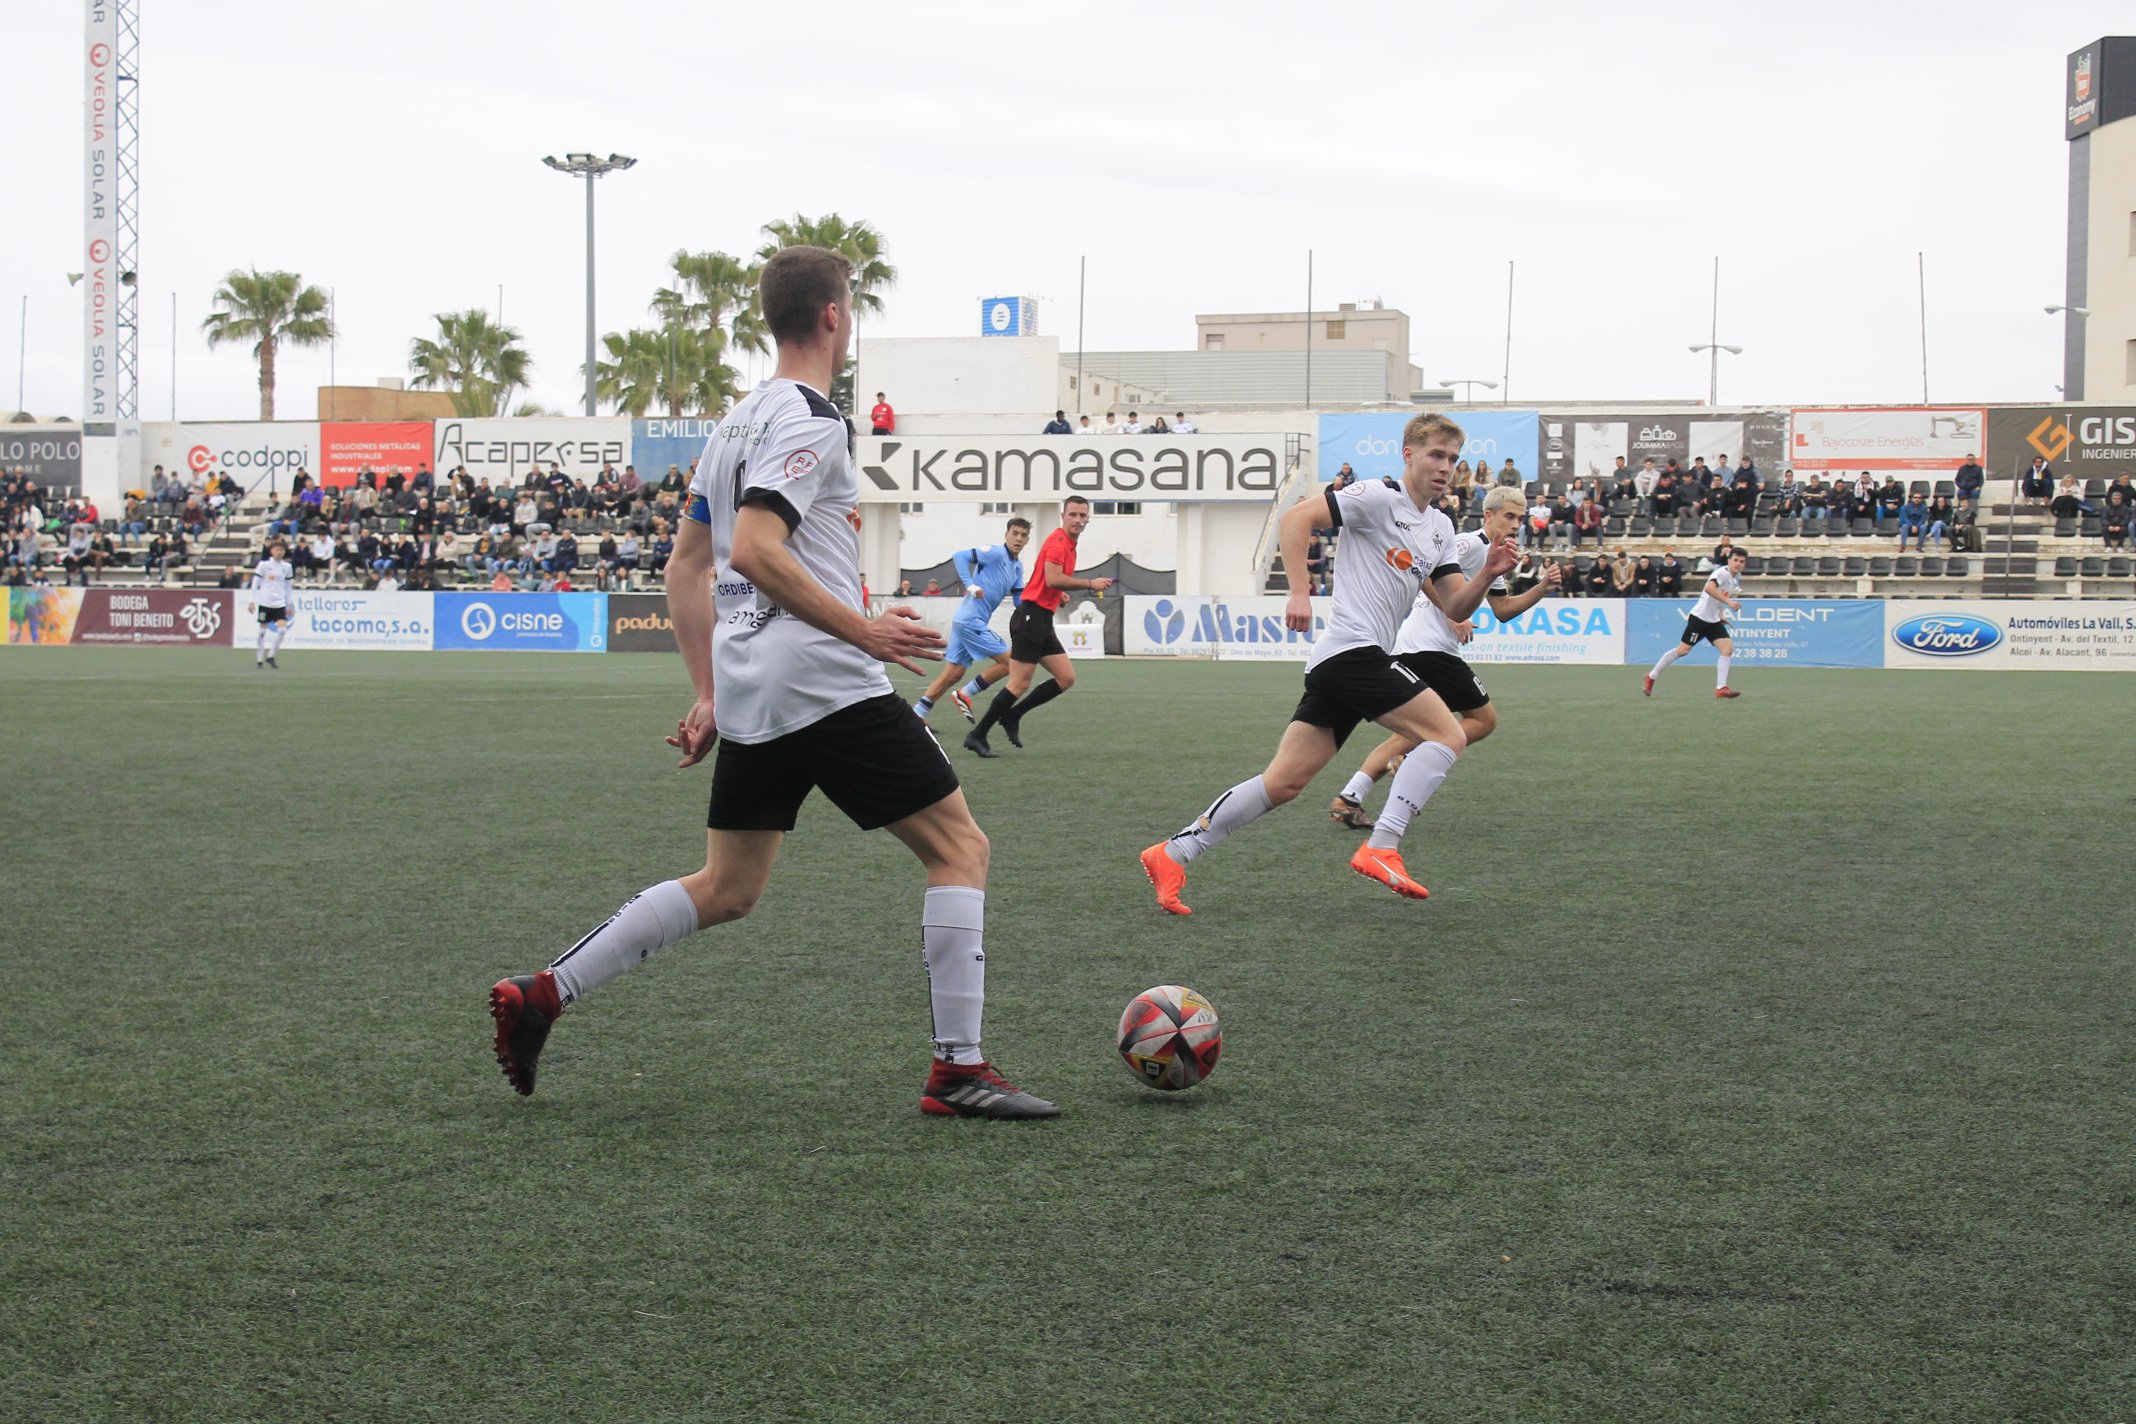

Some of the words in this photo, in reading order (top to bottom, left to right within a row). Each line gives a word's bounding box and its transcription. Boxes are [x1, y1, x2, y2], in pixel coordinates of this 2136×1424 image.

[92, 72, 105, 142] VEOLIA
[92, 150, 105, 220] SOLAR
[92, 268, 105, 338] VEOLIA
[92, 346, 105, 416] SOLAR
[648, 420, 717, 437] EMILIO
[1356, 434, 1398, 456] don
[1822, 435, 1875, 449] Bajocoste
[30, 441, 81, 460] POLO
[222, 444, 309, 472] codopi
[330, 452, 382, 460] INDUSTRIALES
[6, 465, 41, 474] HME
[718, 582, 756, 596] ORDIBE
[110, 596, 149, 610] BODEGA
[298, 597, 366, 611] talleres
[110, 613, 131, 627] TONI
[133, 613, 174, 628] BENEITO
[501, 612, 563, 631] cisne
[1471, 607, 1612, 636] DRASA
[2008, 616, 2080, 629] Automóviles
[2082, 617, 2096, 629] La
[2099, 617, 2124, 631] Vall,
[1728, 628, 1792, 639] NTINYENT
[1913, 619, 1980, 649] Ford
[2010, 634, 2053, 645] Ontinyent
[2060, 635, 2074, 643] Av.
[2077, 635, 2090, 643] del
[2092, 635, 2119, 645] Textil,
[1497, 642, 1534, 653] textile
[1536, 642, 1587, 655] finishing
[2010, 648, 2032, 657] Alcoi
[2039, 648, 2053, 657] Av.
[2055, 648, 2092, 658] Alacant,
[2095, 648, 2107, 657] 96
